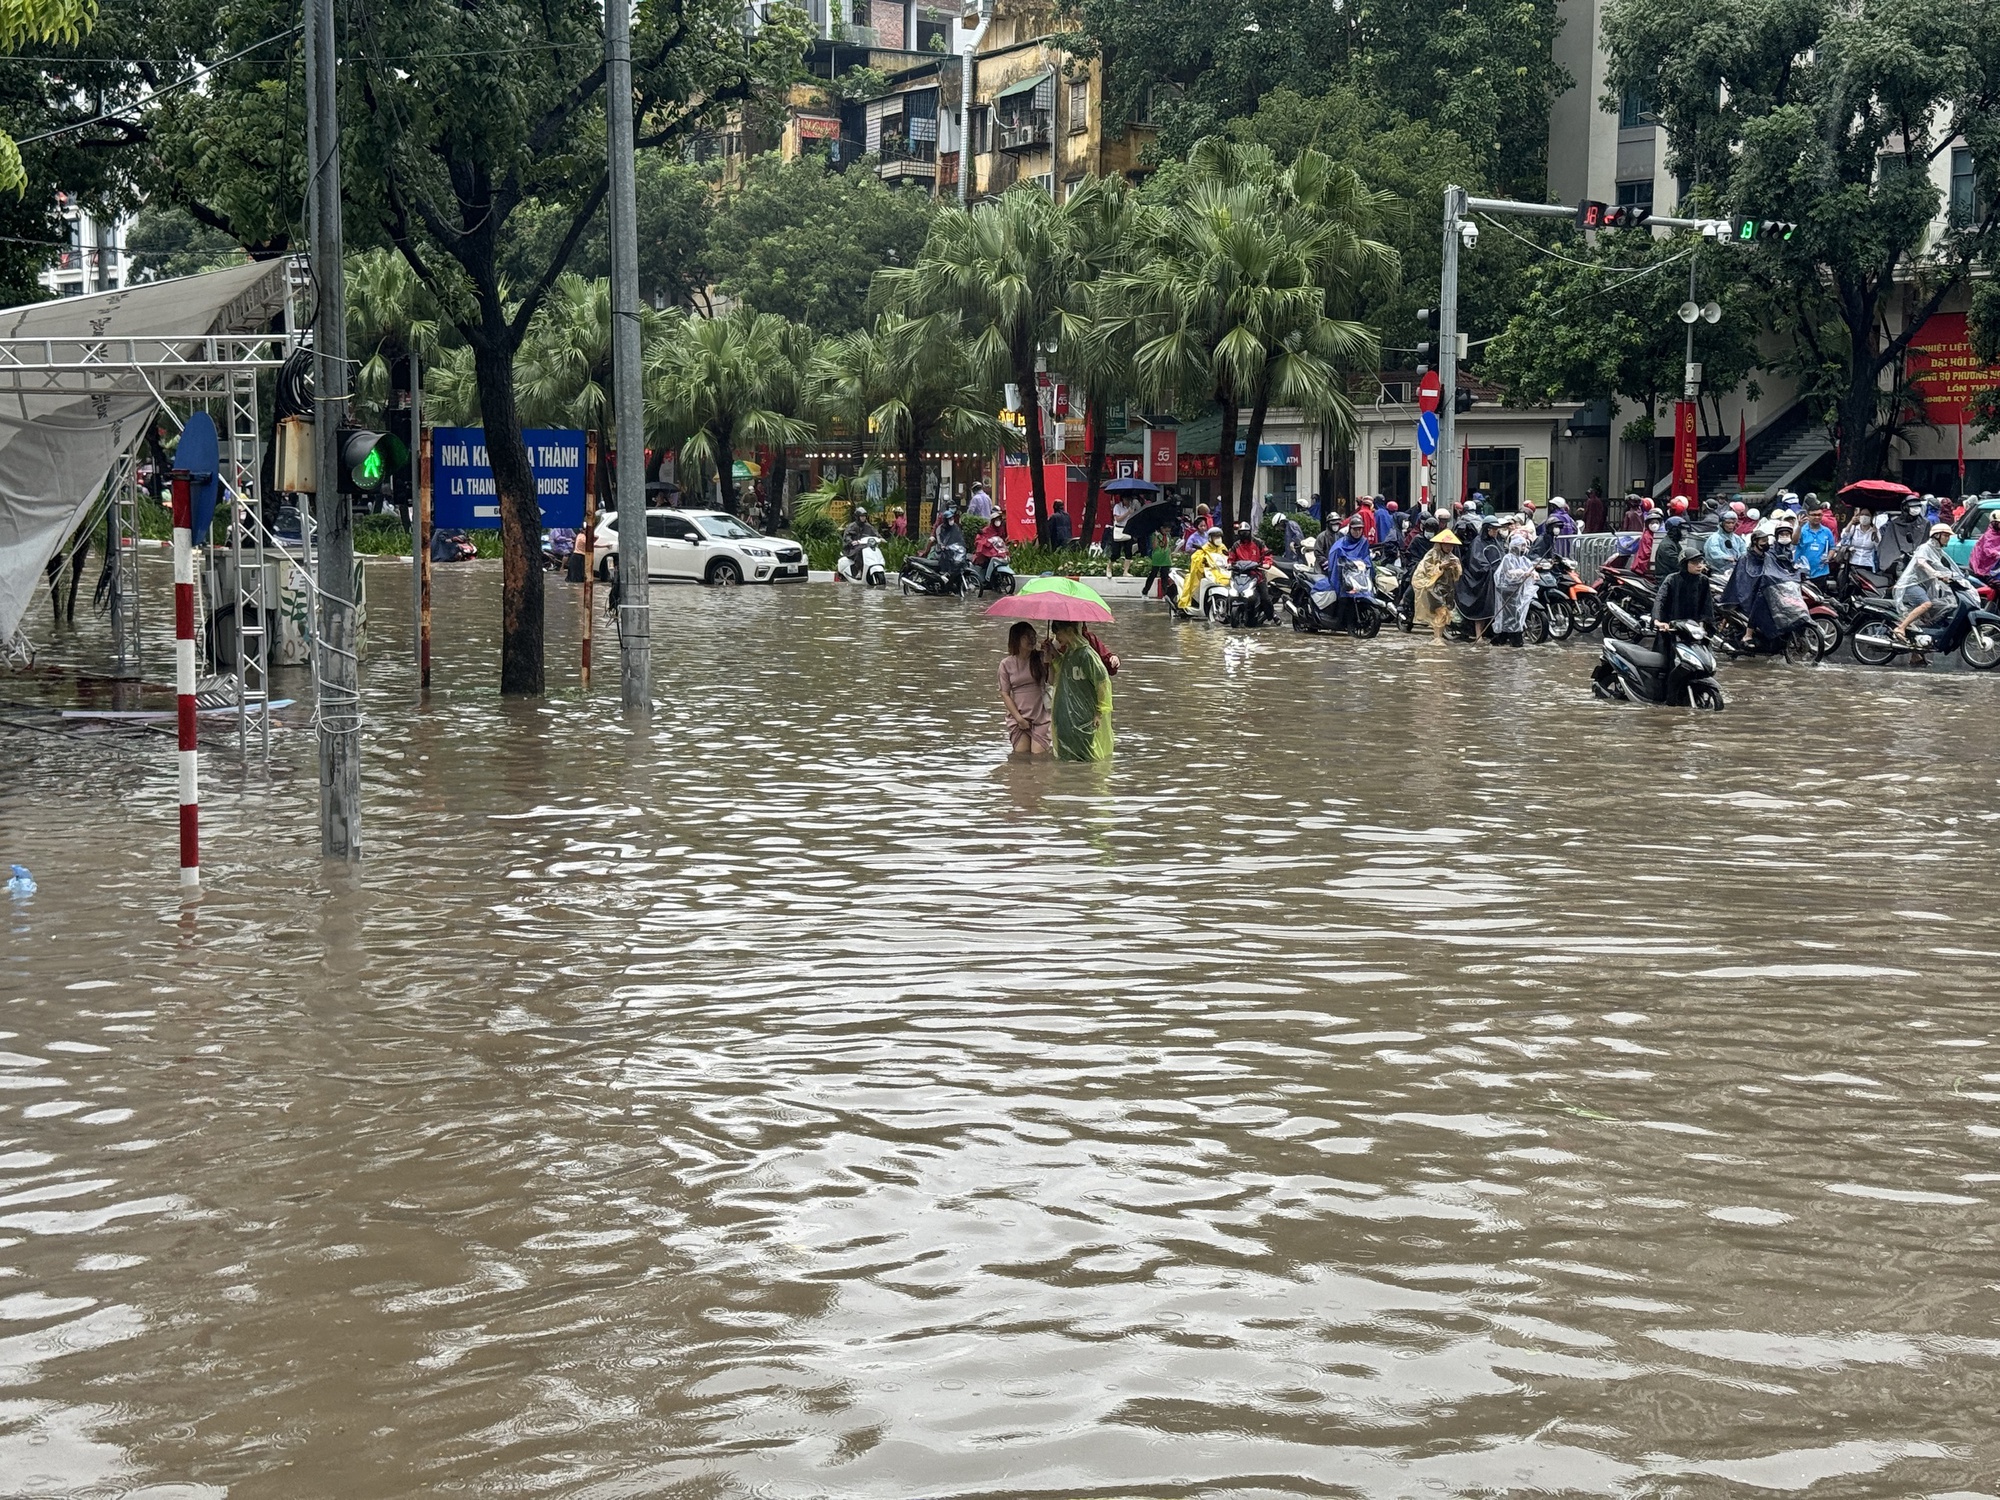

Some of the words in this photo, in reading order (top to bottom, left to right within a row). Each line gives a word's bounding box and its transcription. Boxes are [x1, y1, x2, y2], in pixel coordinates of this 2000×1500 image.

[442, 440, 469, 467] NHÀ
[538, 441, 579, 468] THÀNH
[1157, 450, 1170, 461] 5G
[1286, 456, 1299, 464] ATM
[1121, 465, 1131, 479] P
[451, 478, 464, 495] LA
[466, 478, 497, 495] THAN
[537, 478, 570, 495] HOUSE
[1025, 497, 1035, 516] 5
